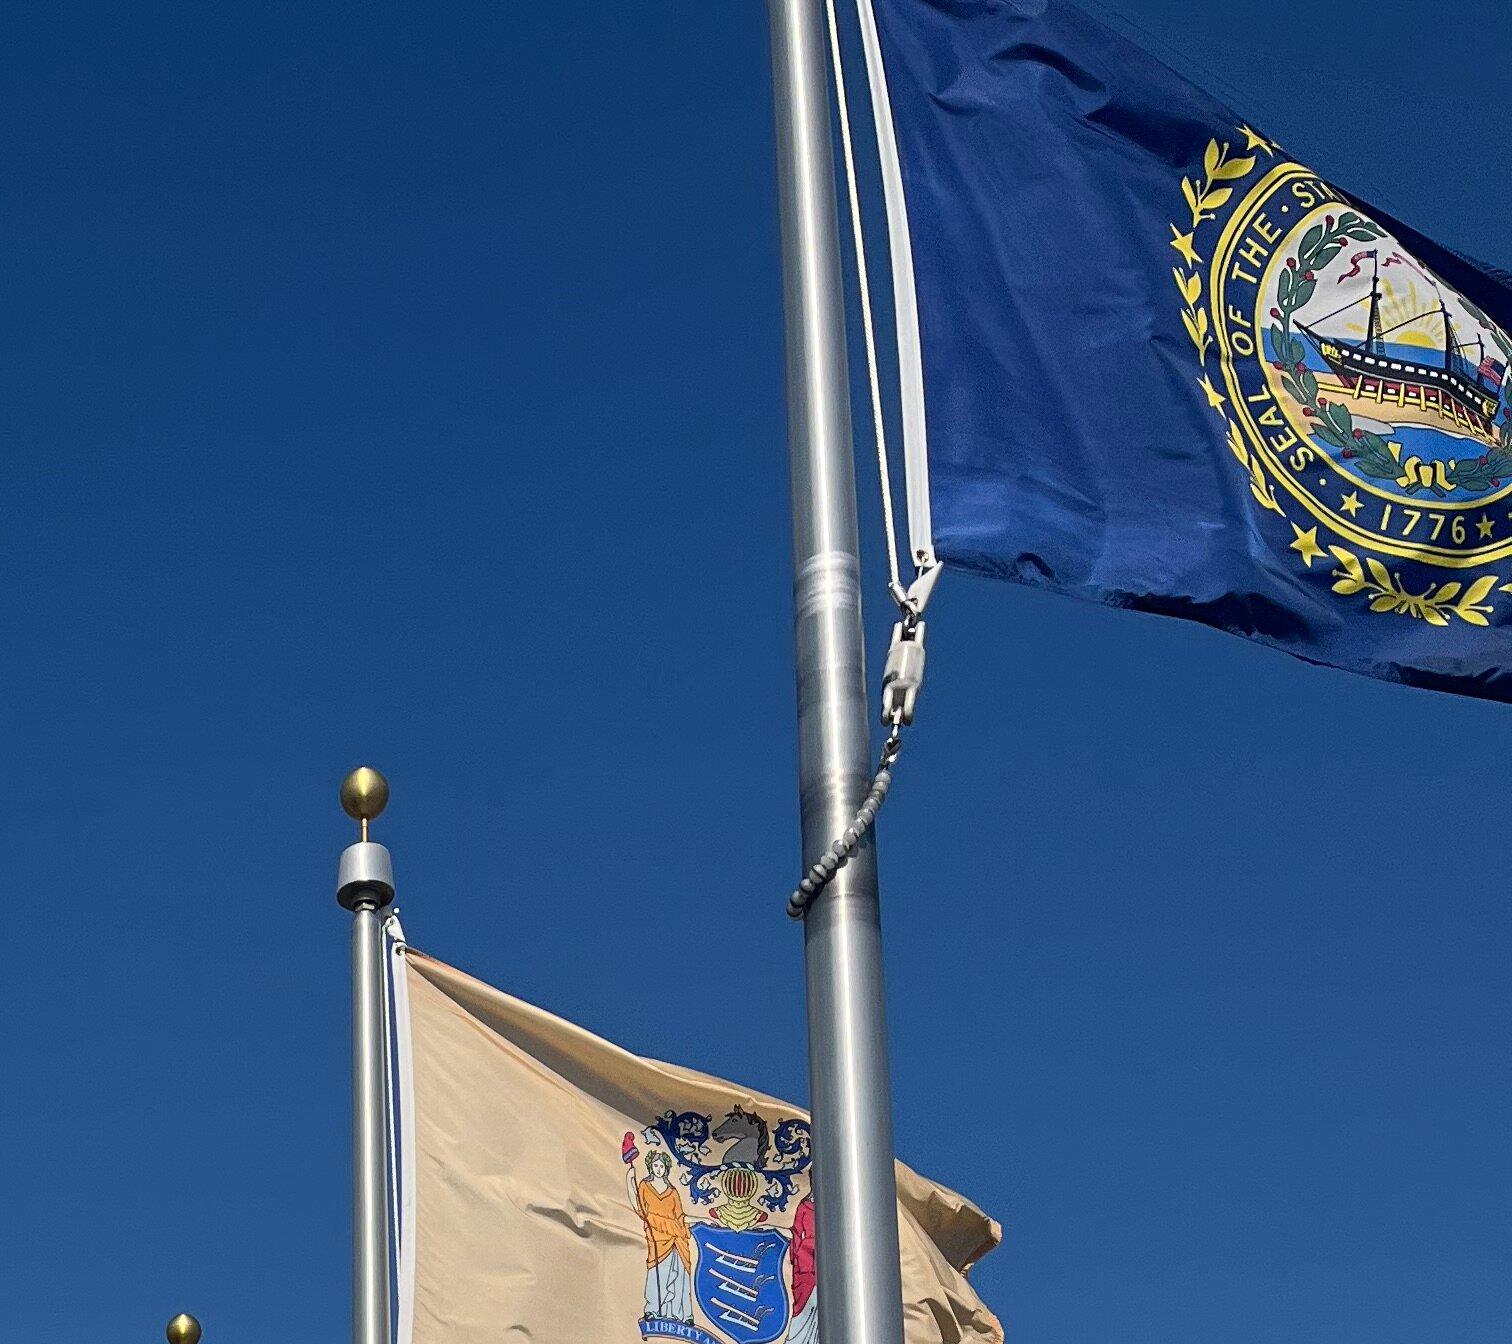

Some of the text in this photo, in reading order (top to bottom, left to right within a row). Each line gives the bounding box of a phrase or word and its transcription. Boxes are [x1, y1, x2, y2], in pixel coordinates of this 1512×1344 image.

[1231, 212, 1283, 284] THE
[1229, 304, 1254, 356] OF
[1248, 384, 1315, 471] SEAL
[1380, 504, 1466, 545] 1776
[645, 1321, 703, 1342] LIBERTY
